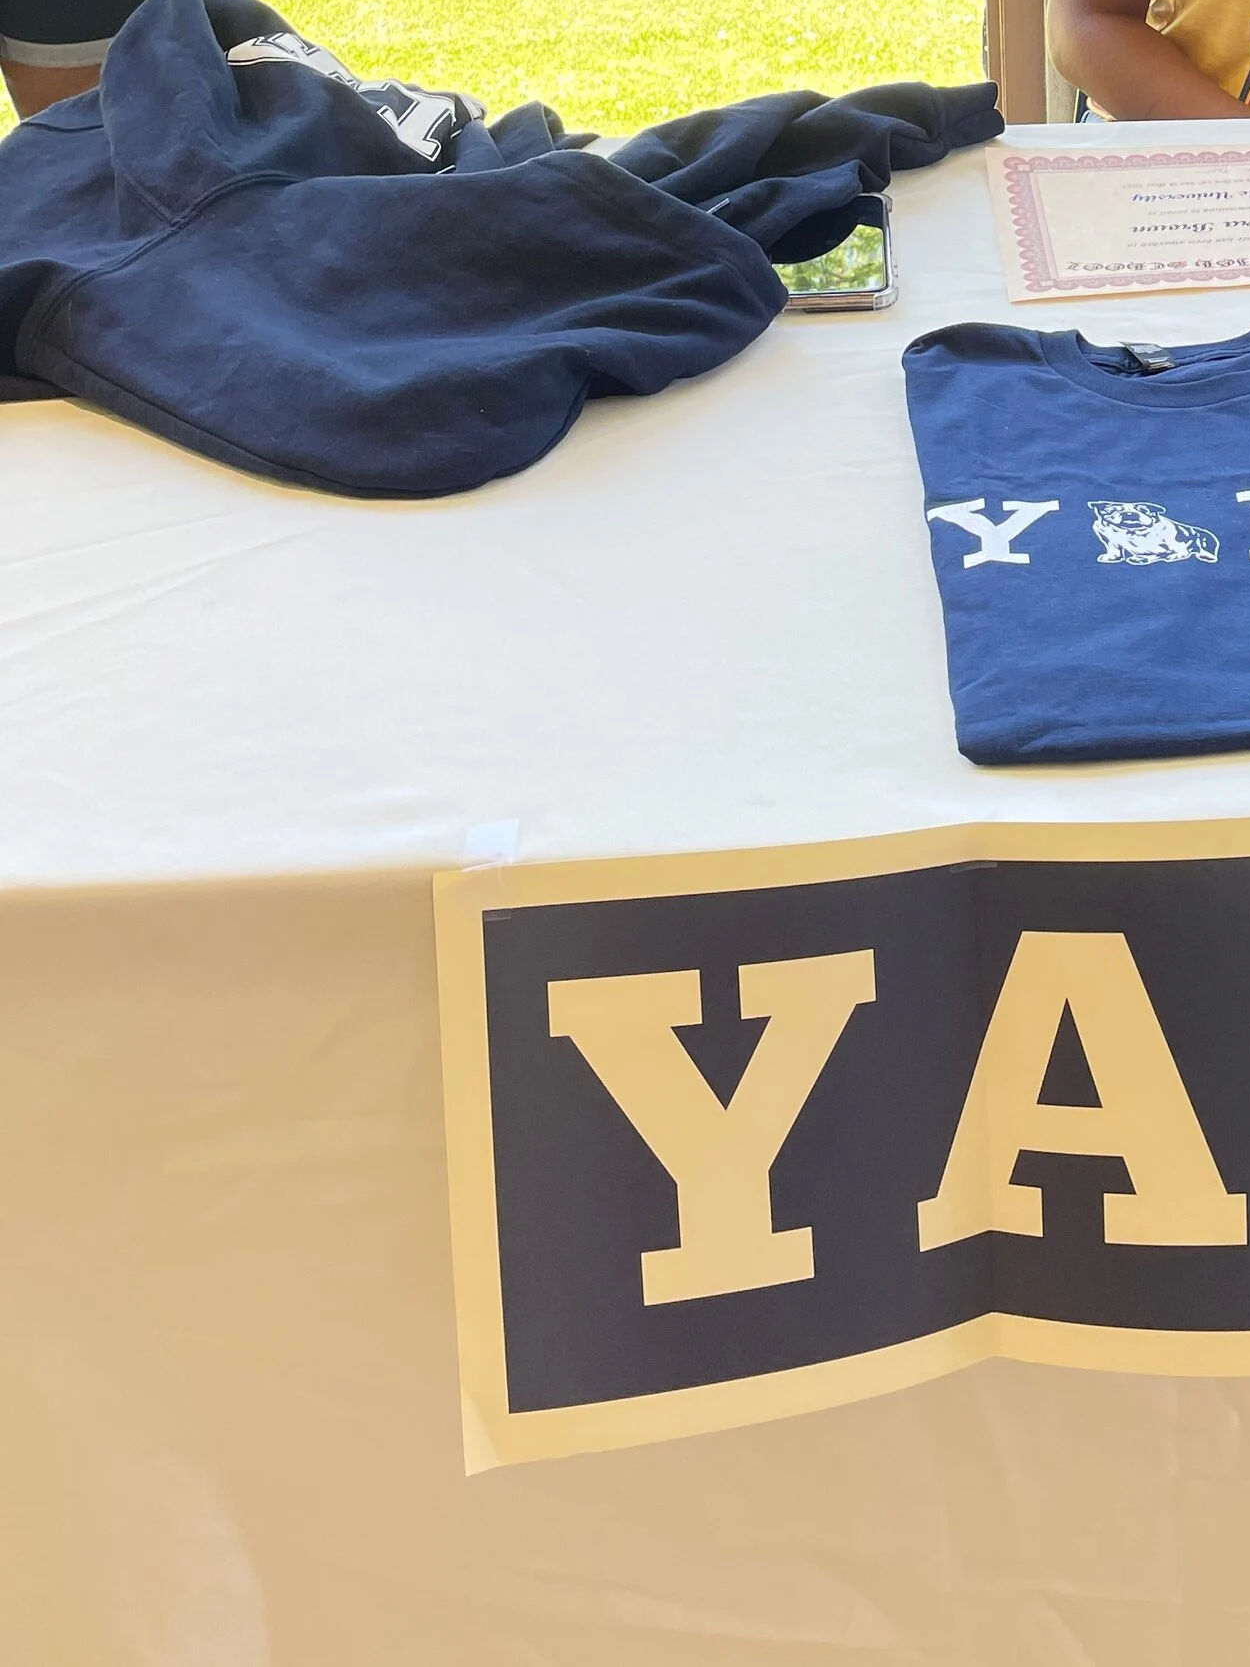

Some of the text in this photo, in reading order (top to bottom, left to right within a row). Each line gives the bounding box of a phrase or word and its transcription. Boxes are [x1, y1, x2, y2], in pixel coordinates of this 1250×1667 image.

[1131, 190, 1234, 203] University
[1131, 221, 1214, 234] Brown
[1066, 260, 1188, 272] SCHOOL
